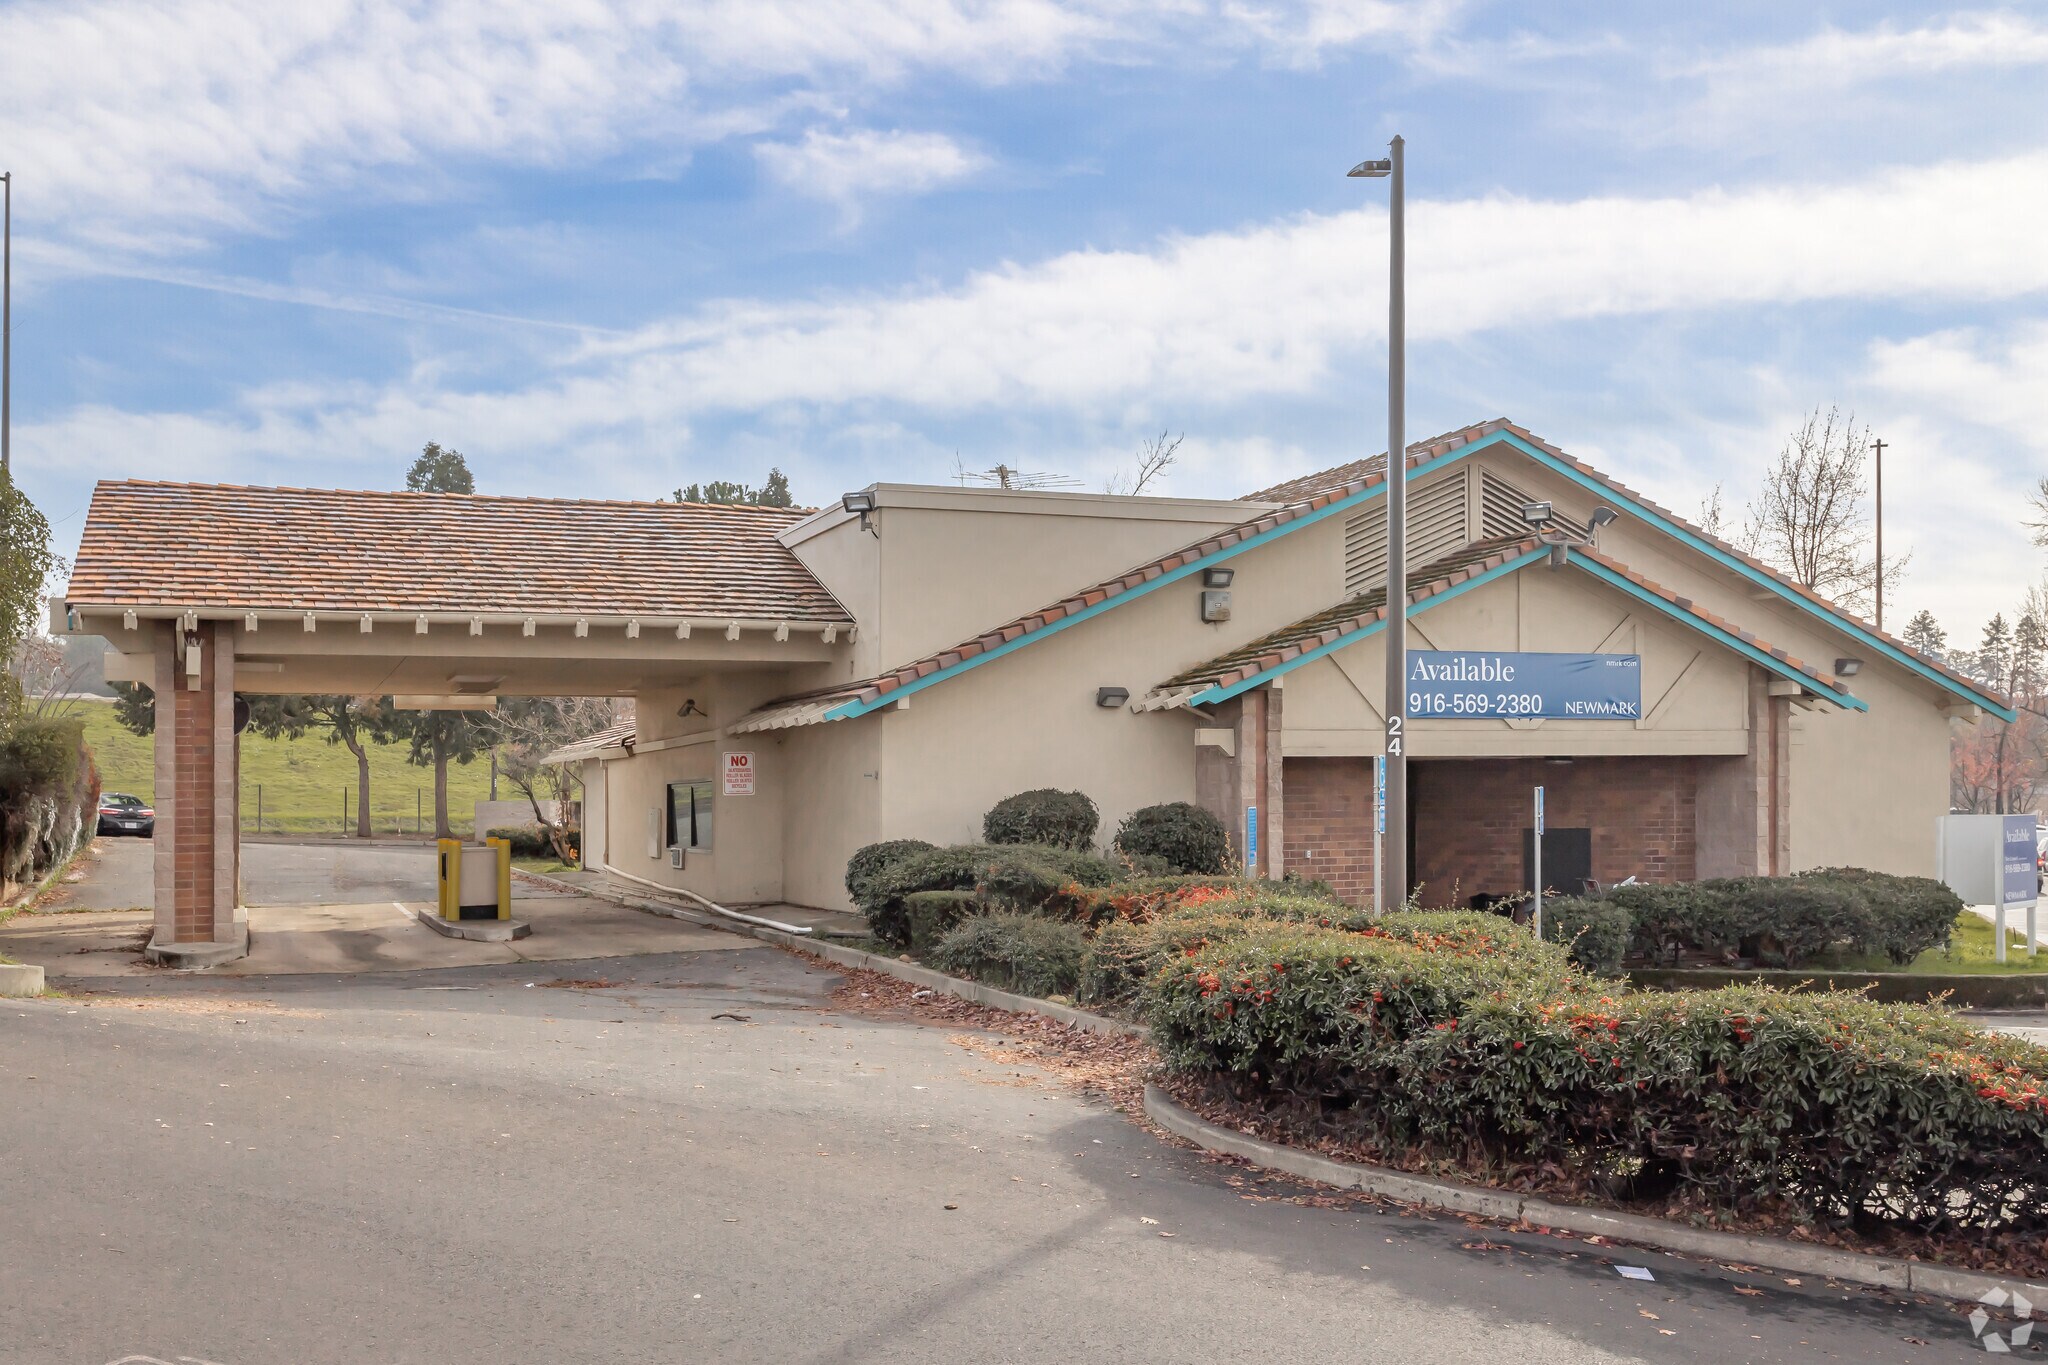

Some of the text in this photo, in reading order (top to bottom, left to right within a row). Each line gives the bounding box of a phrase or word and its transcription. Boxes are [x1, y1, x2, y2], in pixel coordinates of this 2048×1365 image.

[1410, 656, 1515, 682] Available
[1409, 693, 1543, 714] 916-569-2380
[1565, 701, 1637, 714] NEWMARK
[730, 756, 748, 766] NO
[2006, 828, 2030, 842] Available
